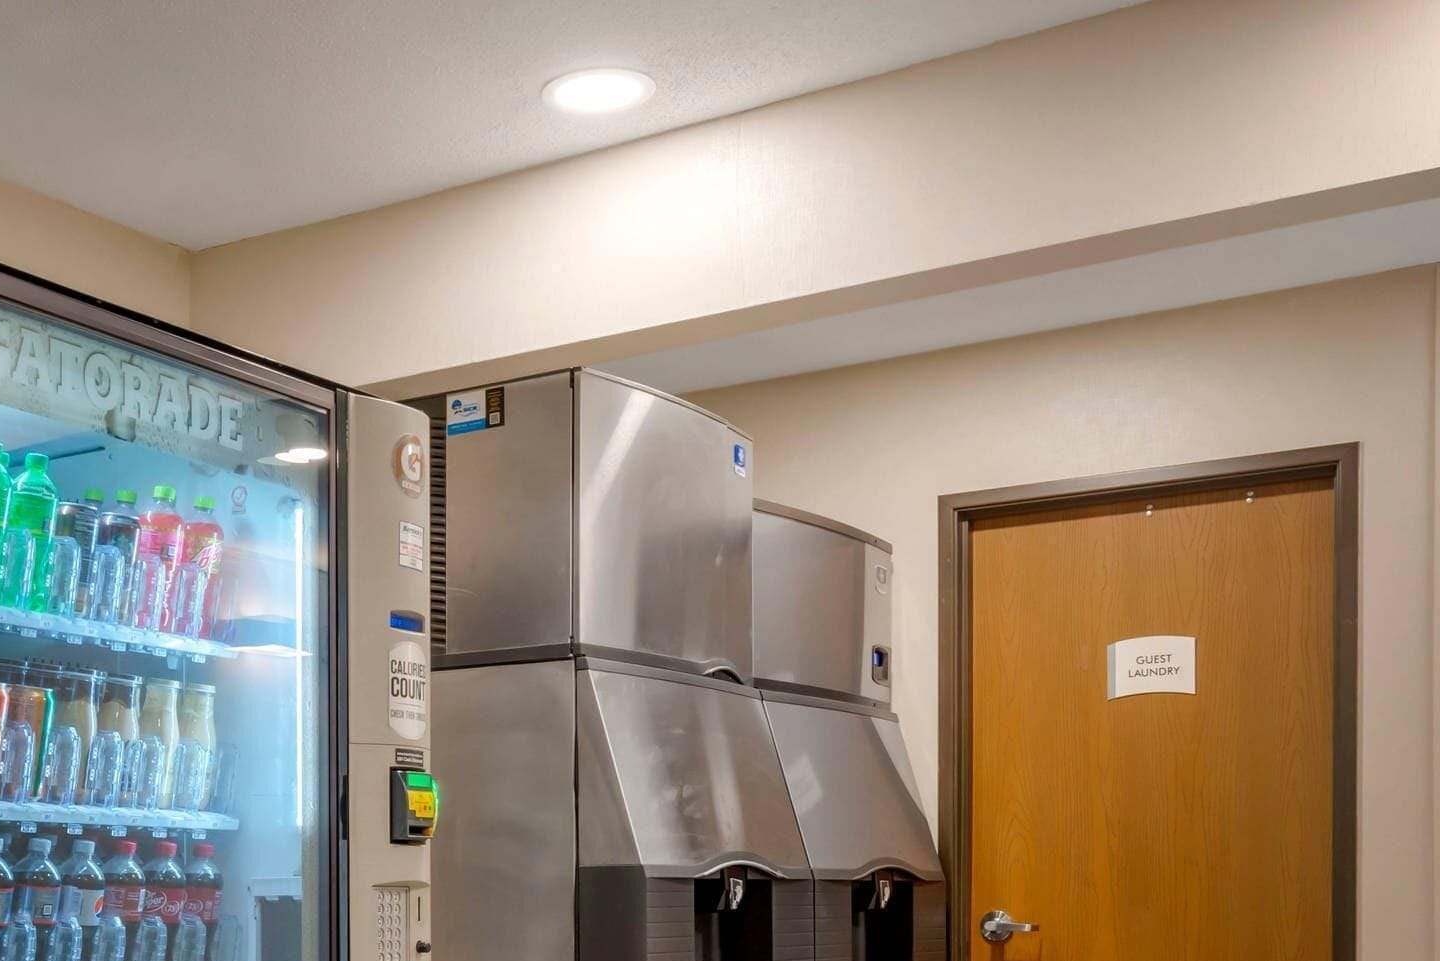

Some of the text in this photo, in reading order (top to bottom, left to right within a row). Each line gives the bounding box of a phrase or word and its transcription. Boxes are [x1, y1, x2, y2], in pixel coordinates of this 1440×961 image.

[1136, 654, 1172, 664] GUEST
[391, 659, 426, 678] CALORIES
[1128, 666, 1180, 678] LAUNDRY
[391, 676, 426, 701] COUNT
